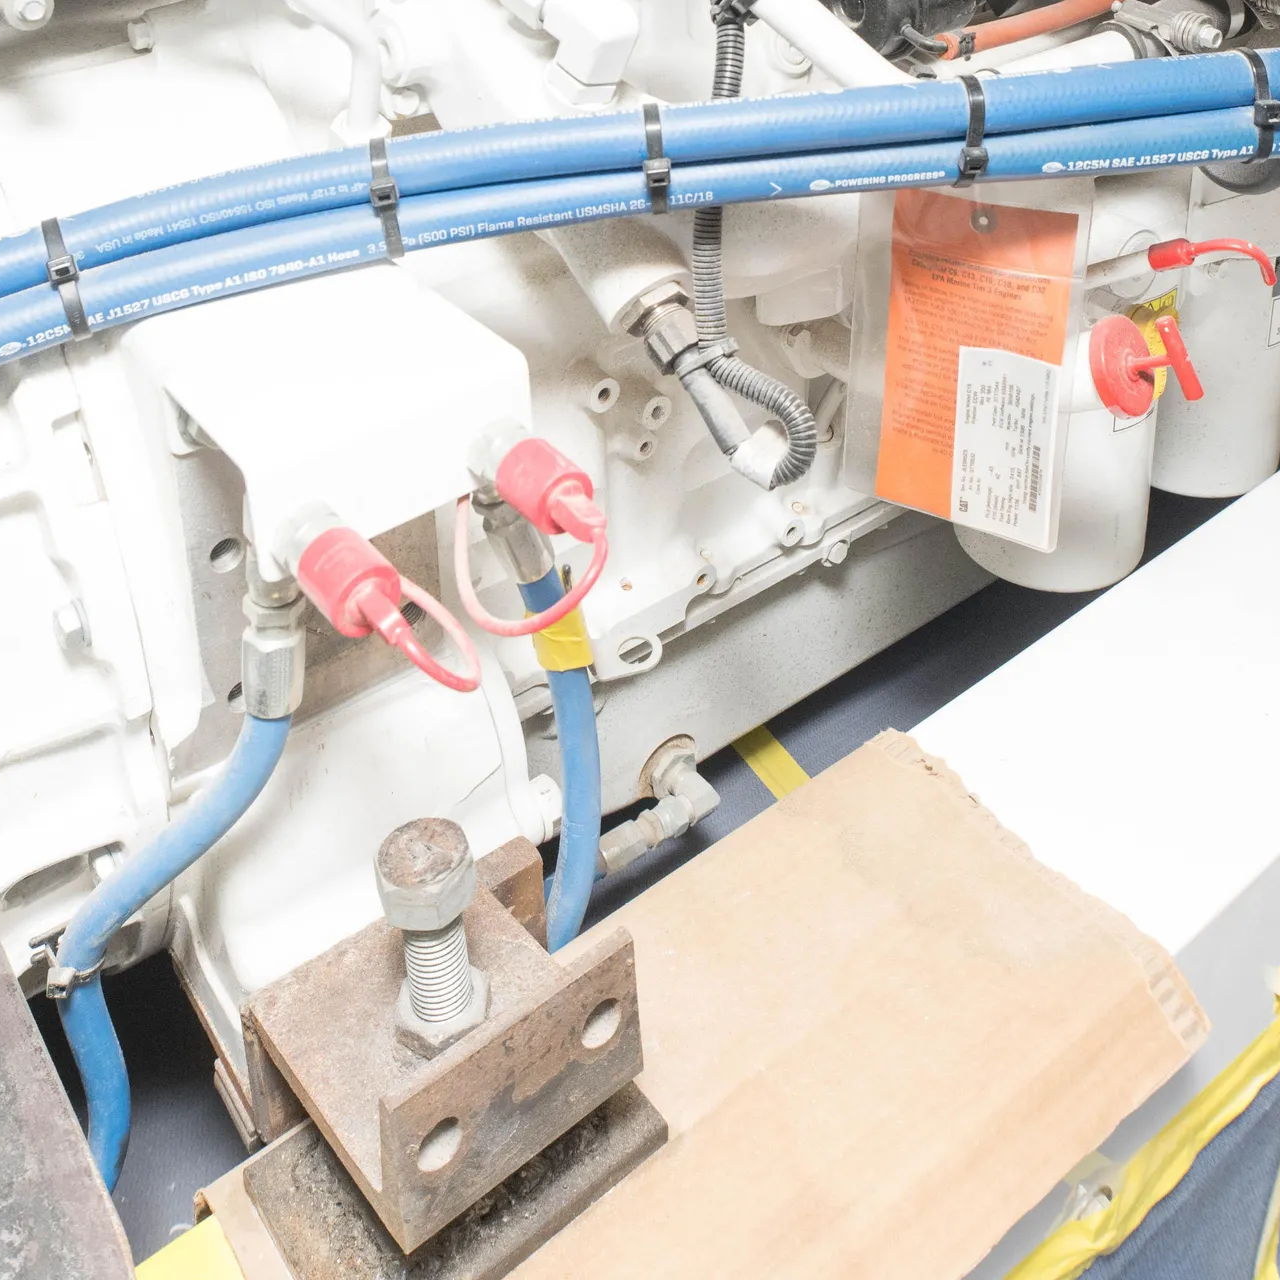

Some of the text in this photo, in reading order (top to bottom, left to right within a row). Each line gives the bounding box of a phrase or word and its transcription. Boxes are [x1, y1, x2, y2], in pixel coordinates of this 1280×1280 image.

[1067, 158, 1111, 172] 12C5M
[1111, 157, 1135, 170] SAE
[1136, 153, 1177, 167] J1527
[1177, 150, 1211, 163] USCG
[1211, 148, 1238, 162] Type
[1238, 145, 1255, 157] A1
[337, 184, 348, 195] to
[834, 174, 885, 189] POWERING
[277, 190, 308, 206] Meets
[309, 185, 336, 199] 212F
[255, 197, 275, 210] ISO
[195, 200, 259, 226] 15540/ISO
[165, 216, 197, 233] 15541
[367, 241, 387, 255] 3.5
[478, 217, 516, 234] Flame
[517, 209, 572, 229] Resistant
[575, 201, 627, 221] USMSHA
[121, 234, 133, 246] in
[133, 225, 164, 242] Made
[94, 237, 121, 254] USA
[107, 300, 150, 324] J1527
[152, 290, 188, 309] USCG
[191, 281, 223, 303] Type
[225, 275, 242, 291] A1
[243, 269, 268, 286] ISO
[328, 247, 361, 263] Hose
[972, 282, 986, 292] Tier
[993, 287, 1023, 301] Engines
[1016, 282, 1030, 291] and
[958, 499, 968, 512] CAT
